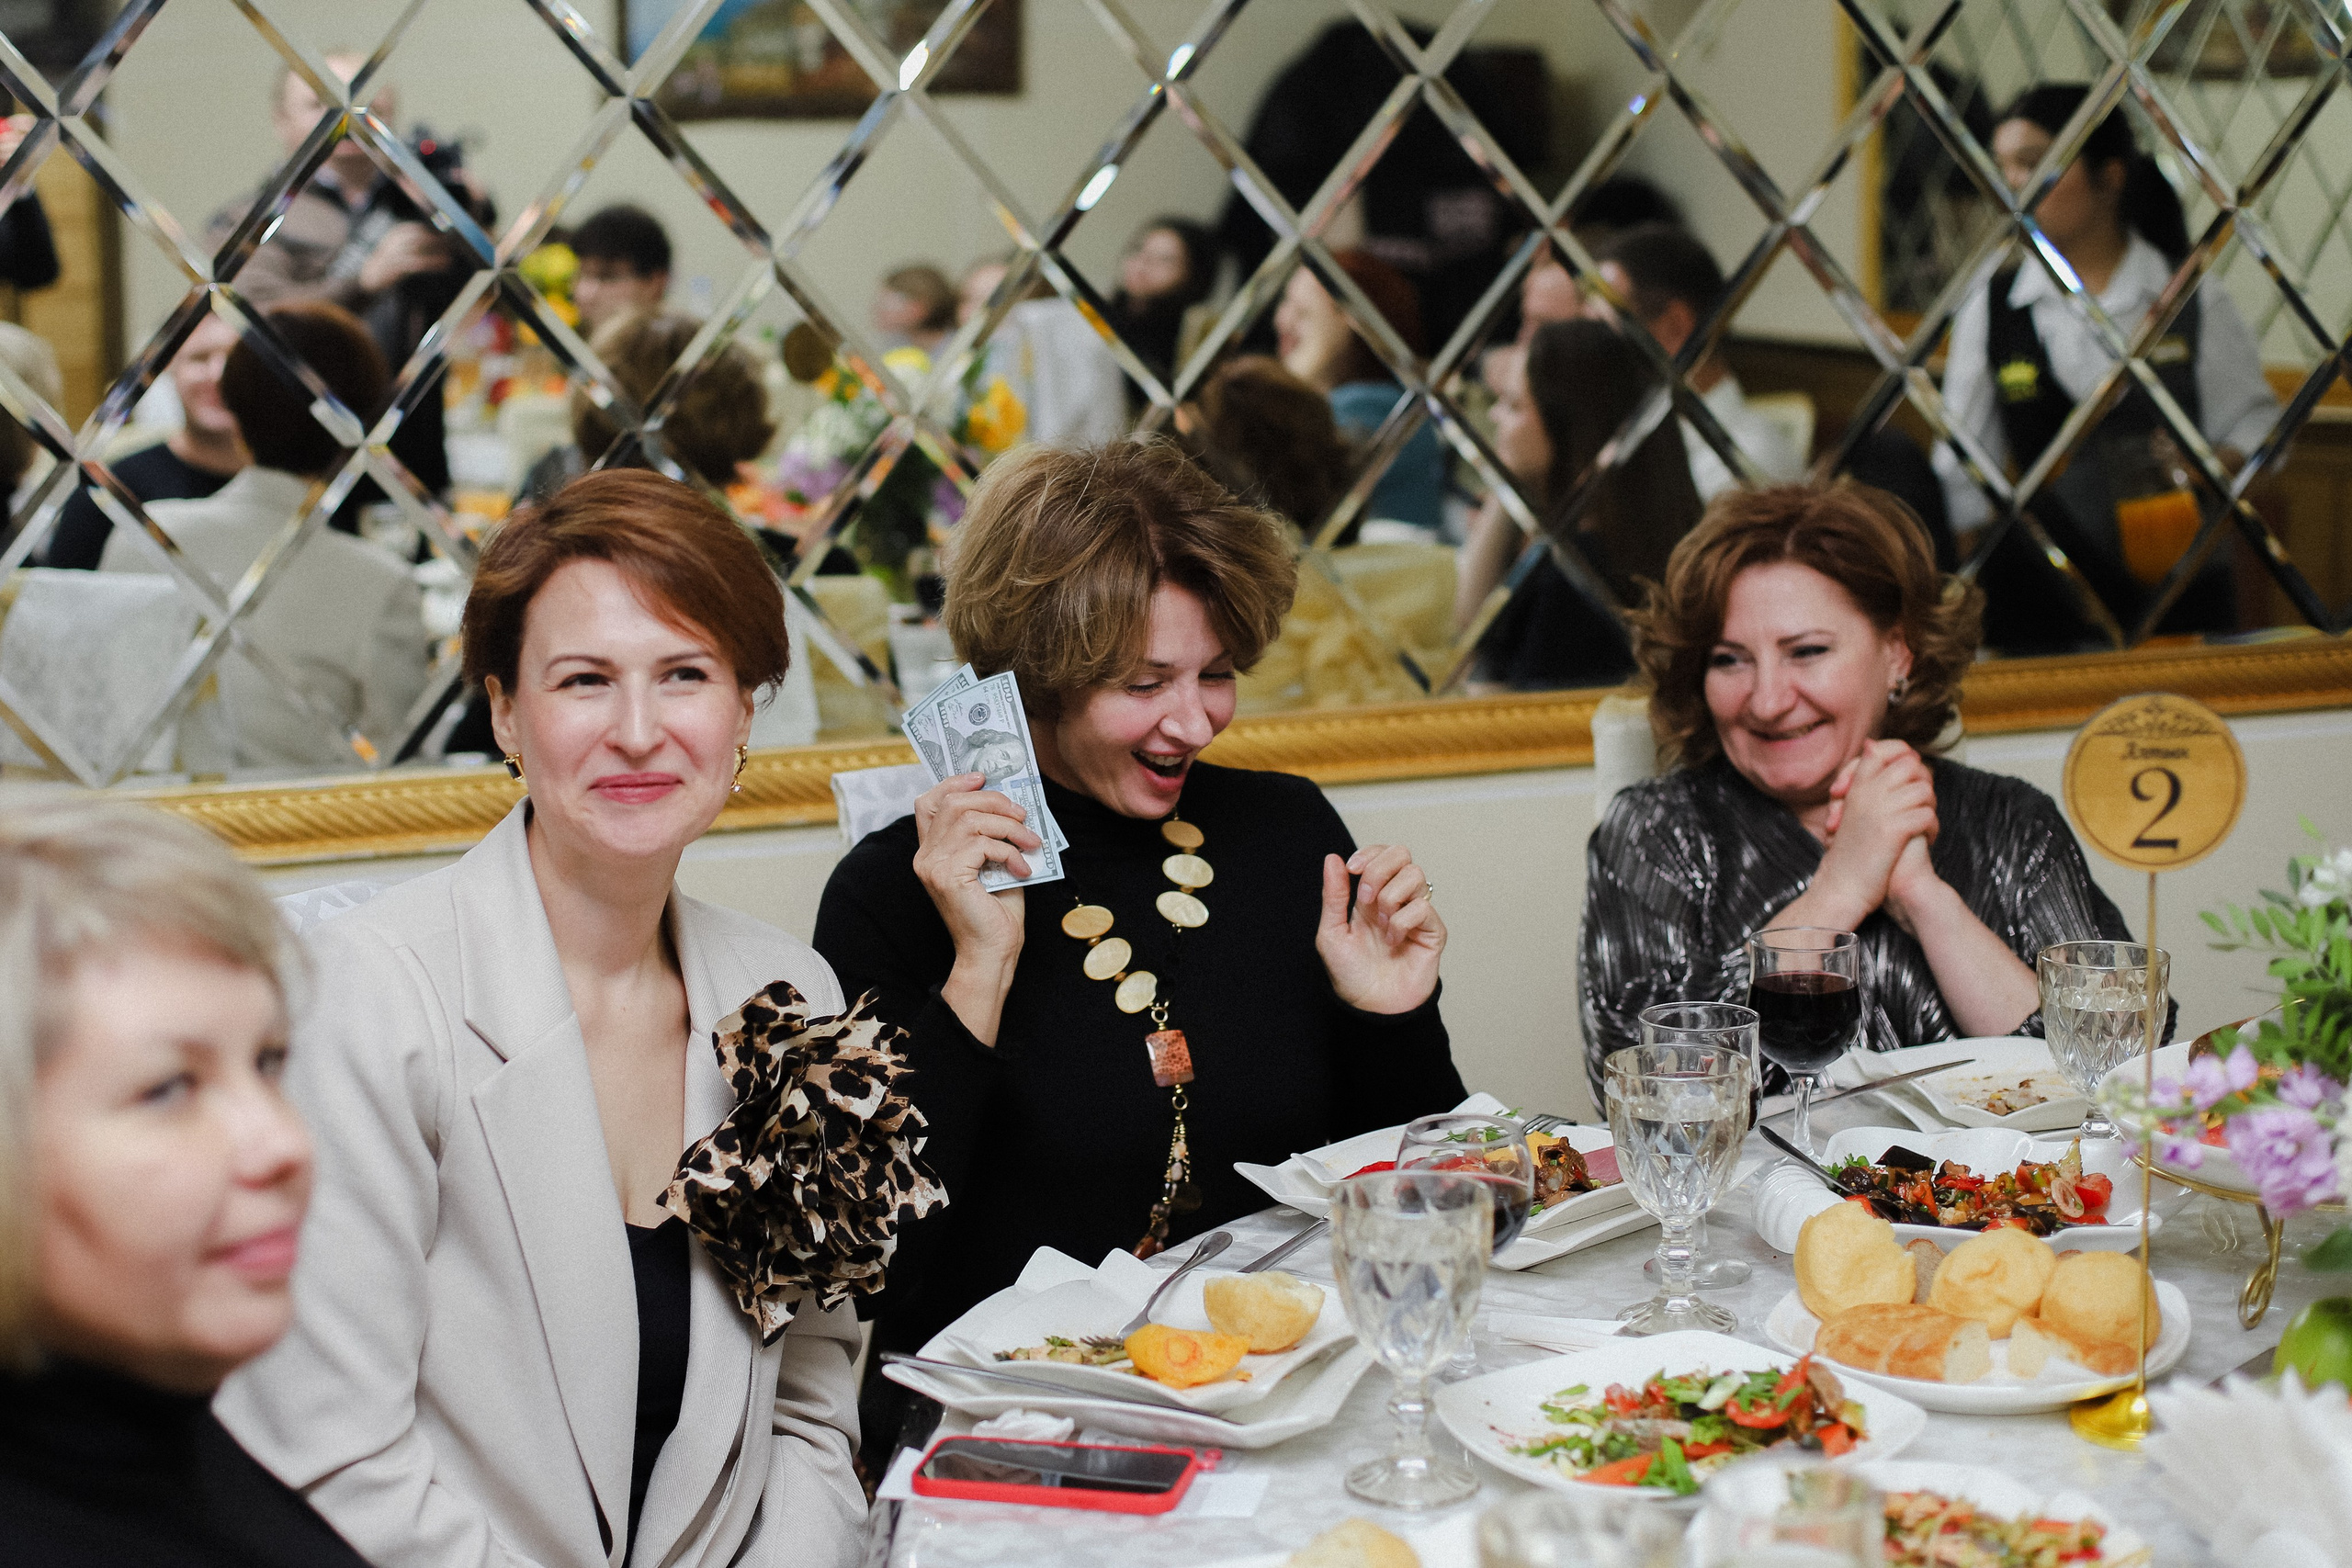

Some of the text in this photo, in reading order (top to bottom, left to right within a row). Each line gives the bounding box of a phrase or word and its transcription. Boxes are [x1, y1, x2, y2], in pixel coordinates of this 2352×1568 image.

[1001, 677, 1014, 704] 100
[938, 705, 951, 729] 100
[910, 723, 924, 744] 100
[2131, 766, 2182, 851] 2
